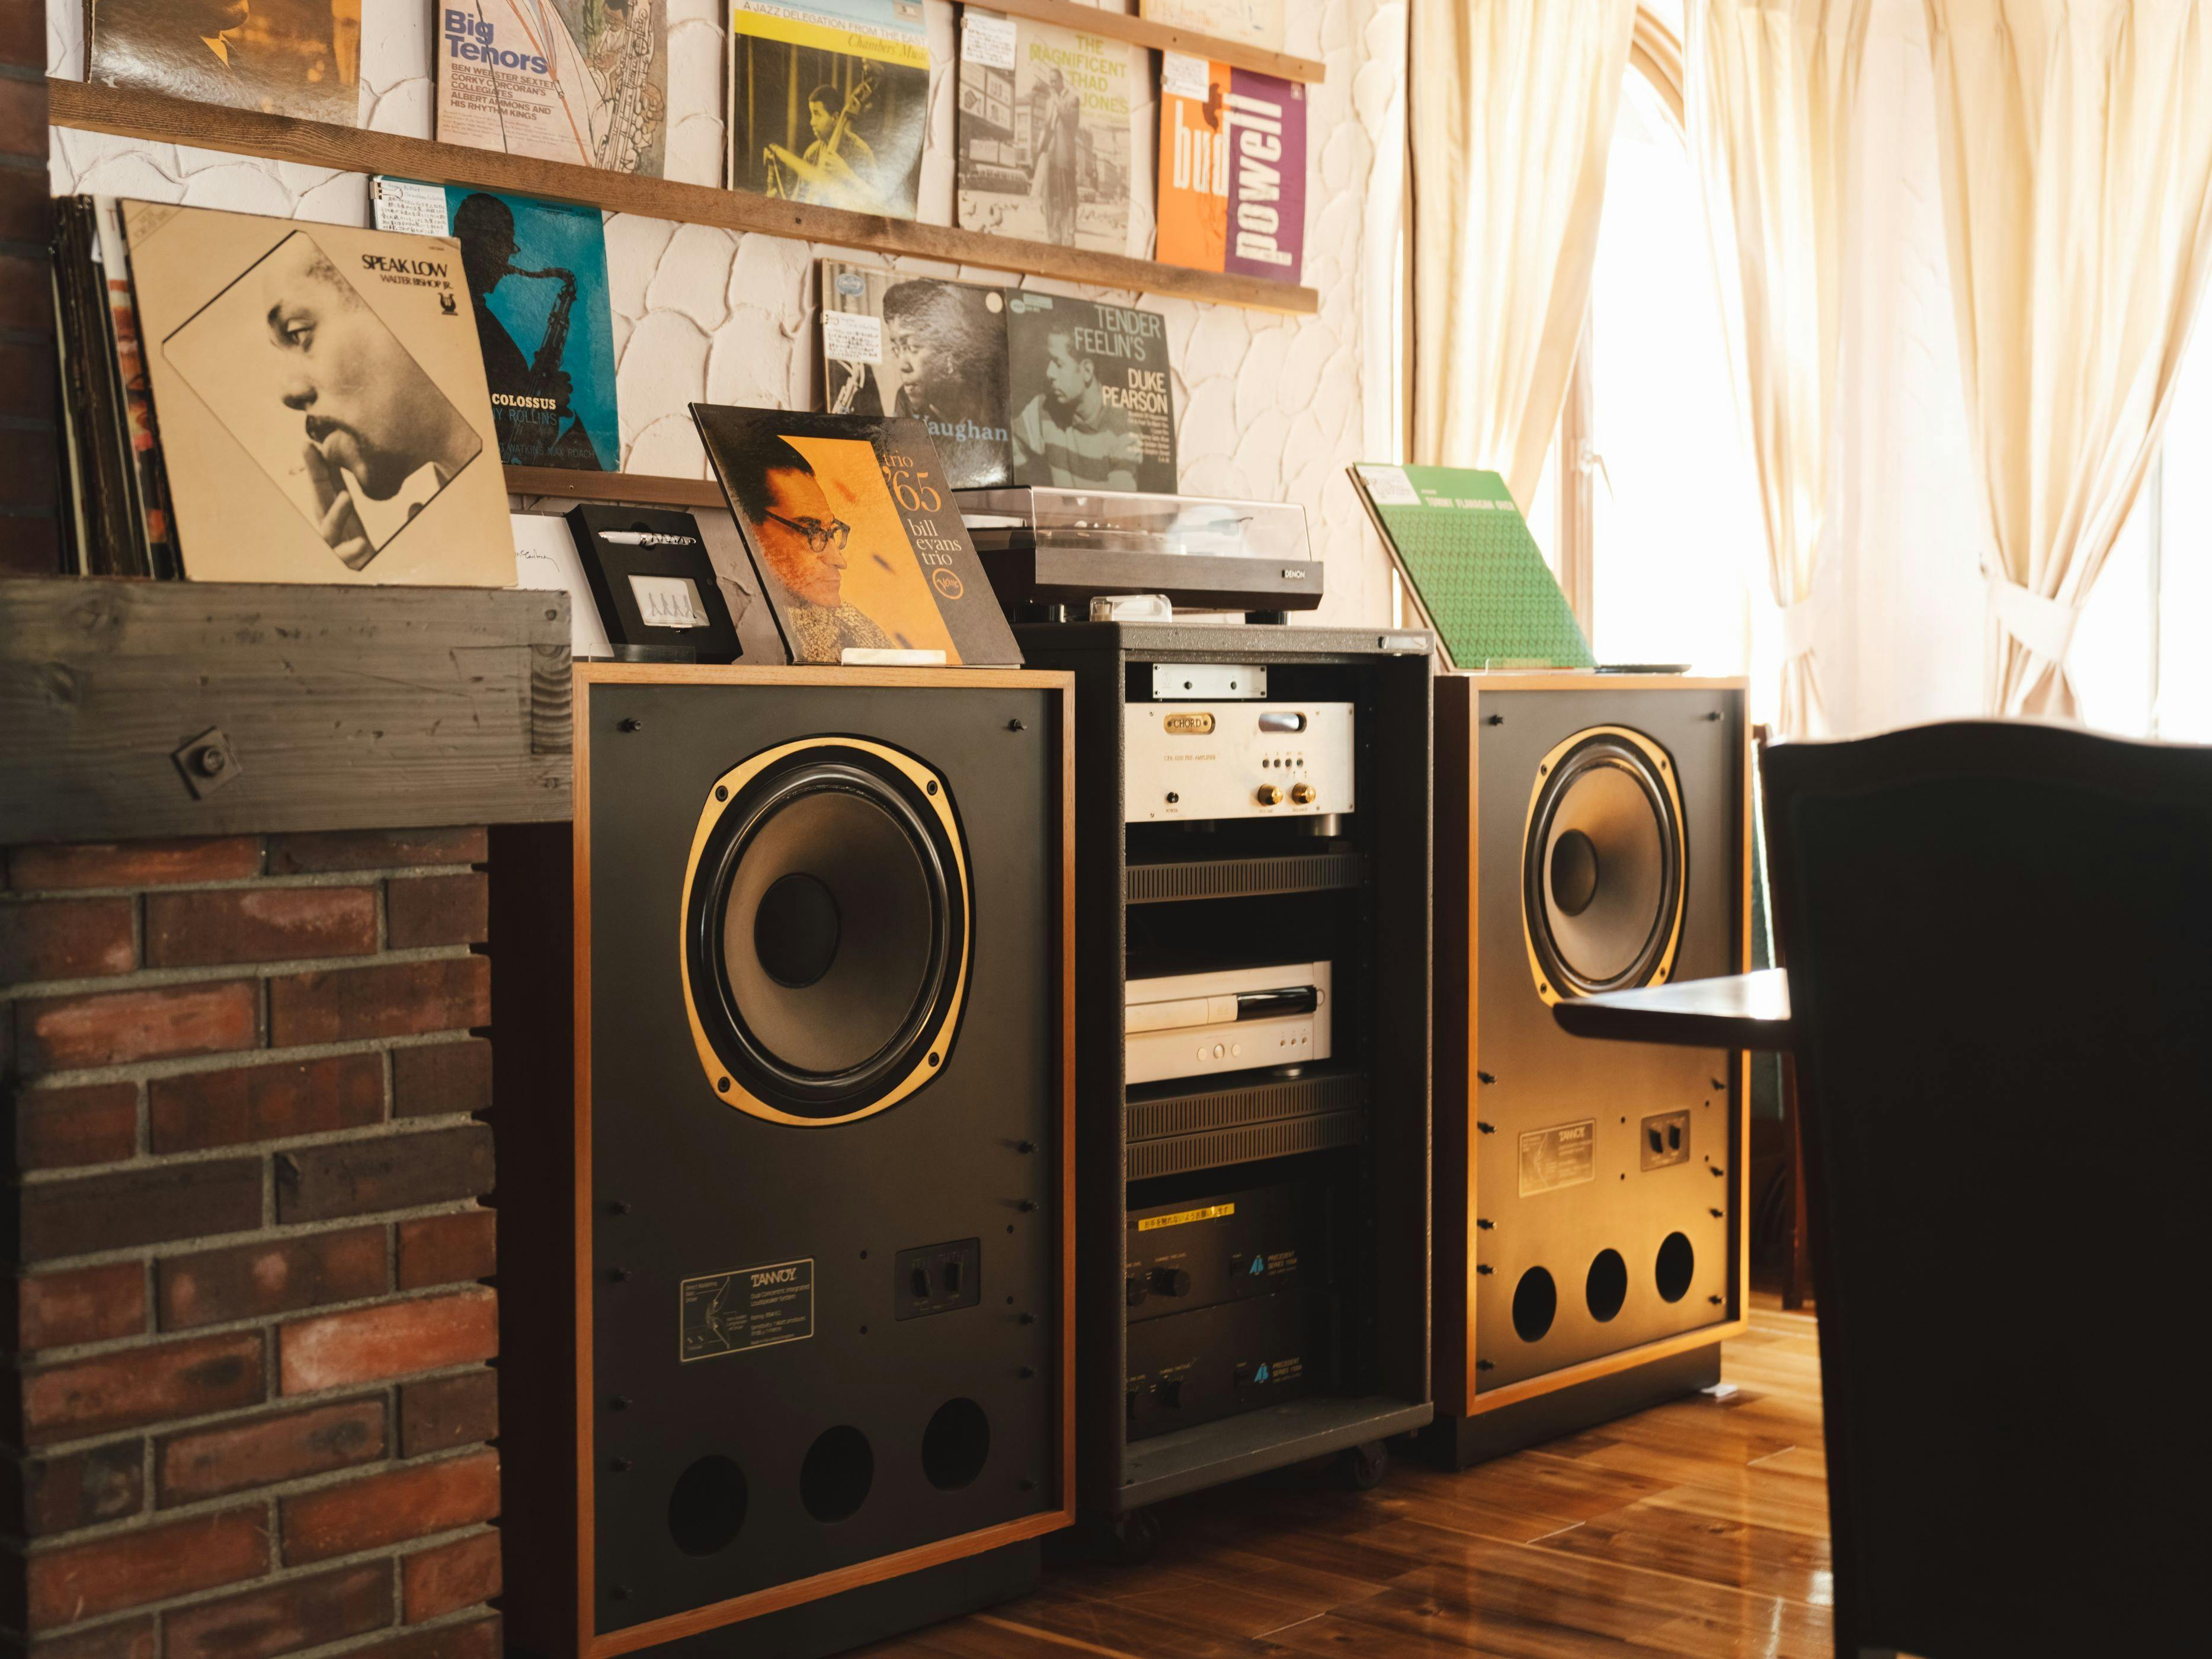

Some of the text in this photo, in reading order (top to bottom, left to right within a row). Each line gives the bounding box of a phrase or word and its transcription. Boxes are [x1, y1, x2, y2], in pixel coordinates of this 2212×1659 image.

[445, 9, 494, 45] Big
[753, 4, 780, 17] JAZZ
[783, 8, 846, 30] DELEGATION
[848, 21, 878, 37] FROM
[881, 29, 899, 41] THE
[445, 34, 548, 74] Tenors
[1075, 34, 1104, 55] THE
[1029, 43, 1126, 78] MAGNIFICENT
[451, 73, 546, 97] CORKY CORCORAN'S
[452, 63, 555, 88] BEN WEBSTER SEXTET
[1068, 71, 1108, 92] THAD
[451, 81, 513, 98] COLLEGIATES
[451, 91, 551, 115] ALBERT AMMONS AND
[451, 100, 537, 120] HIS RHYTHM KINGS
[1079, 92, 1128, 114] JONES
[1173, 100, 1231, 197] bud
[1221, 92, 1292, 266] powell
[361, 254, 447, 277] SPEAK LOW
[380, 274, 412, 286] WALTER
[412, 277, 441, 288] BISHOP
[1094, 305, 1161, 339] TENDER
[1074, 326, 1145, 362] FEELIN'S
[1128, 367, 1166, 393] DUKE
[492, 393, 556, 410] COLOSSUS
[1102, 386, 1168, 414] PEARSON
[509, 409, 557, 426] ROLLINS
[913, 414, 1008, 442] aughan
[507, 445, 543, 456] WATKINS
[547, 447, 564, 457] MAX
[568, 449, 595, 459] ROACH
[883, 450, 913, 467] trio
[882, 466, 942, 513] '65
[907, 519, 938, 536] bill
[916, 539, 962, 551] evans
[921, 551, 952, 566] trio
[1285, 569, 1305, 578] DENON
[1174, 719, 1201, 728] CHORD
[751, 1268, 797, 1287] TANNOY
